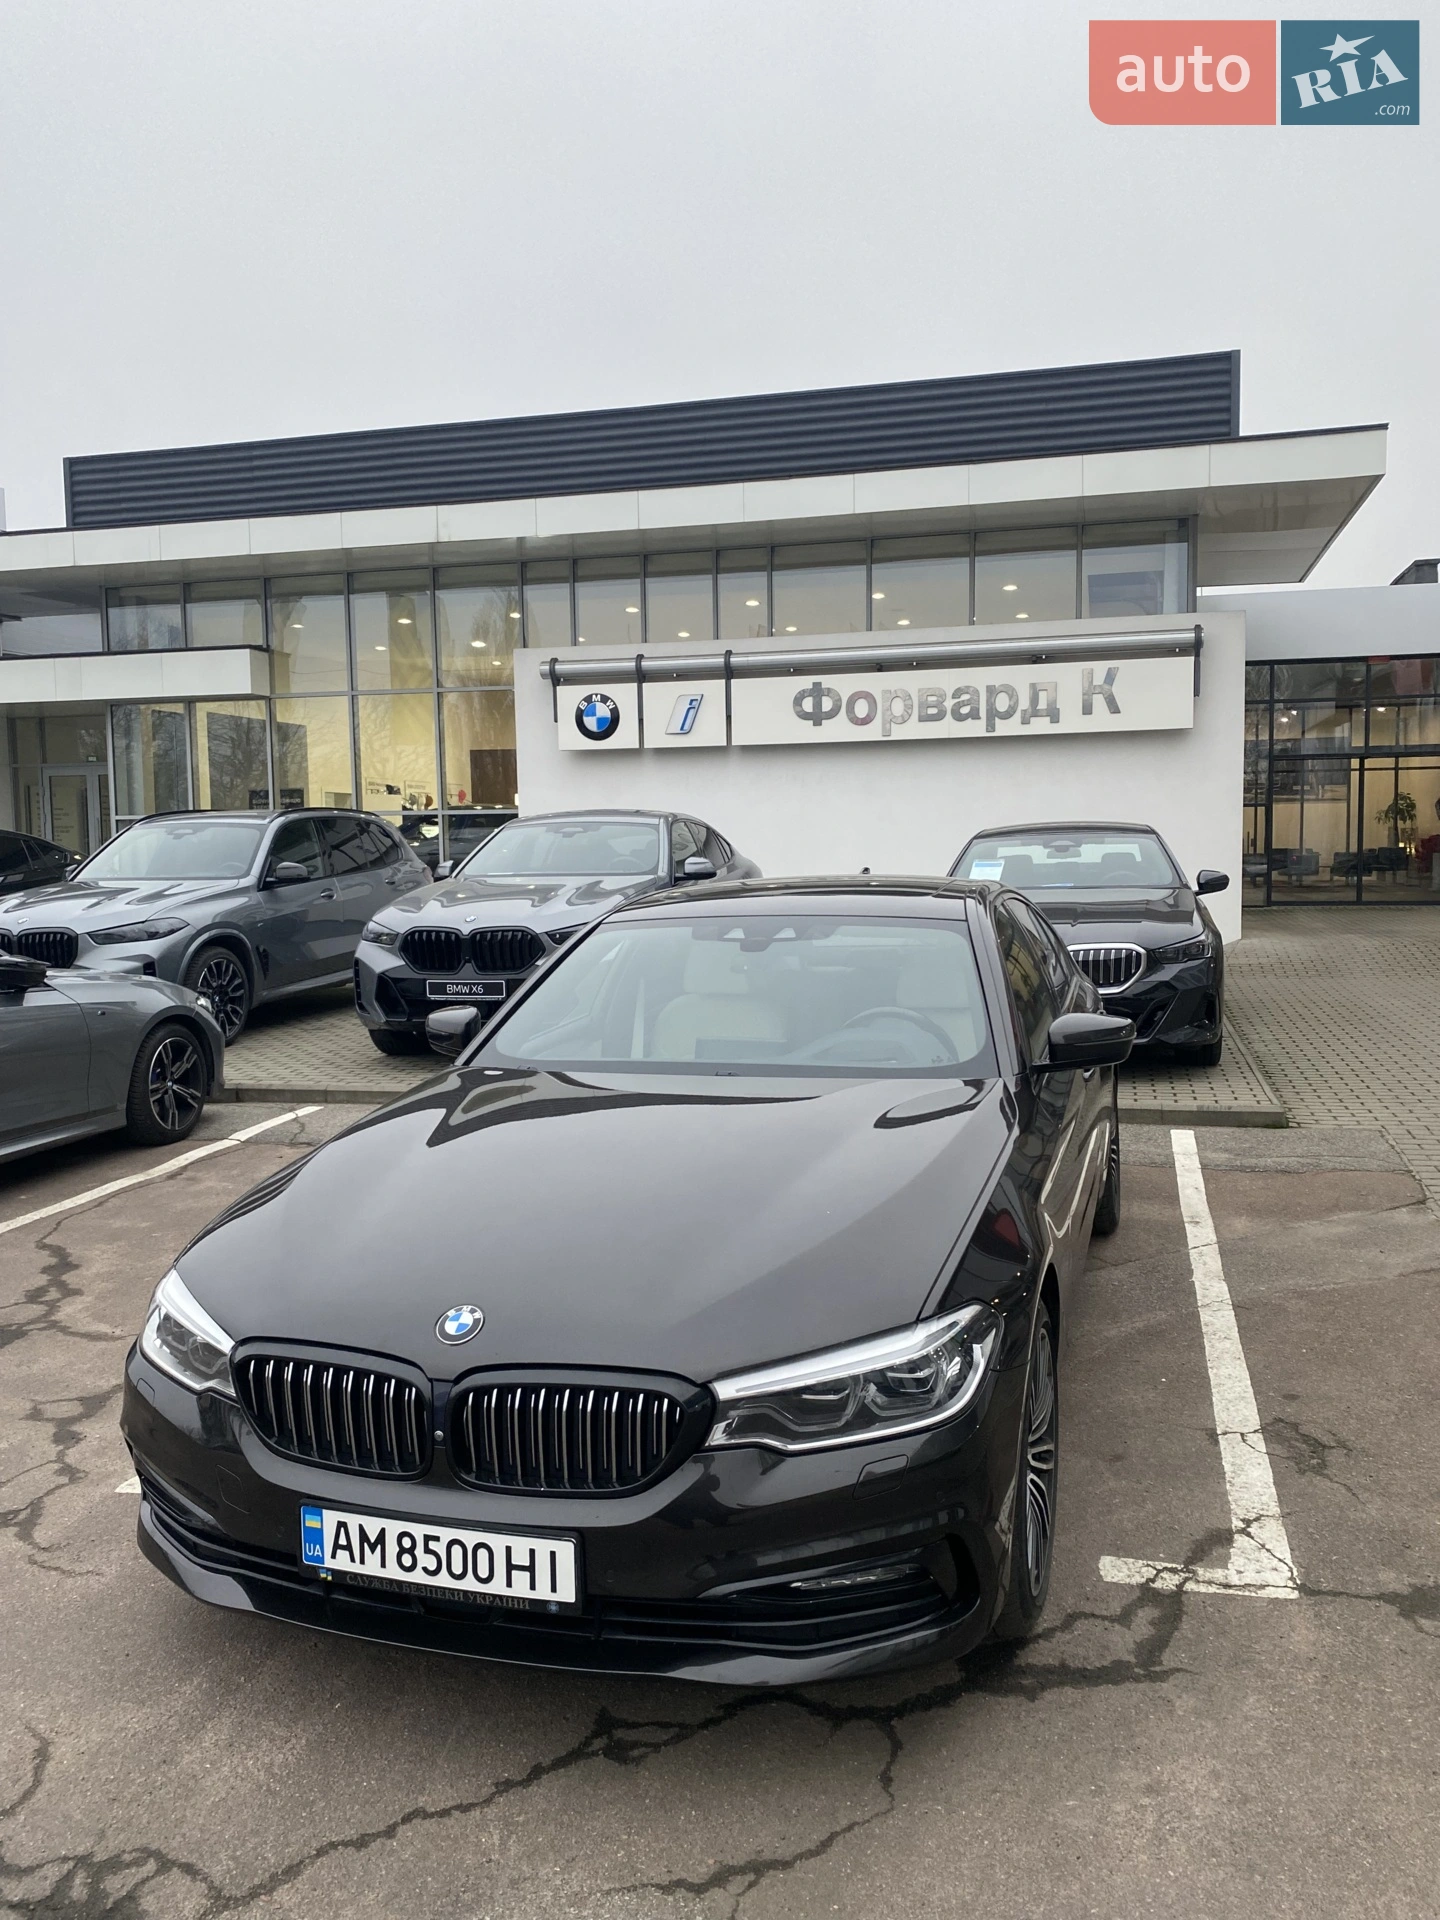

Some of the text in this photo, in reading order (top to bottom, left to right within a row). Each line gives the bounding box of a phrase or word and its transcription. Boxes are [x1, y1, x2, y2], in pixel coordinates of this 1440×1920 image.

[578, 694, 616, 710] BMW
[793, 666, 1121, 737] Форвард К
[446, 984, 484, 994] BMW X6
[305, 1542, 323, 1558] UA
[346, 1573, 531, 1610] СЛУЖБА БЕЗПЕКИ УКРАЇНИ
